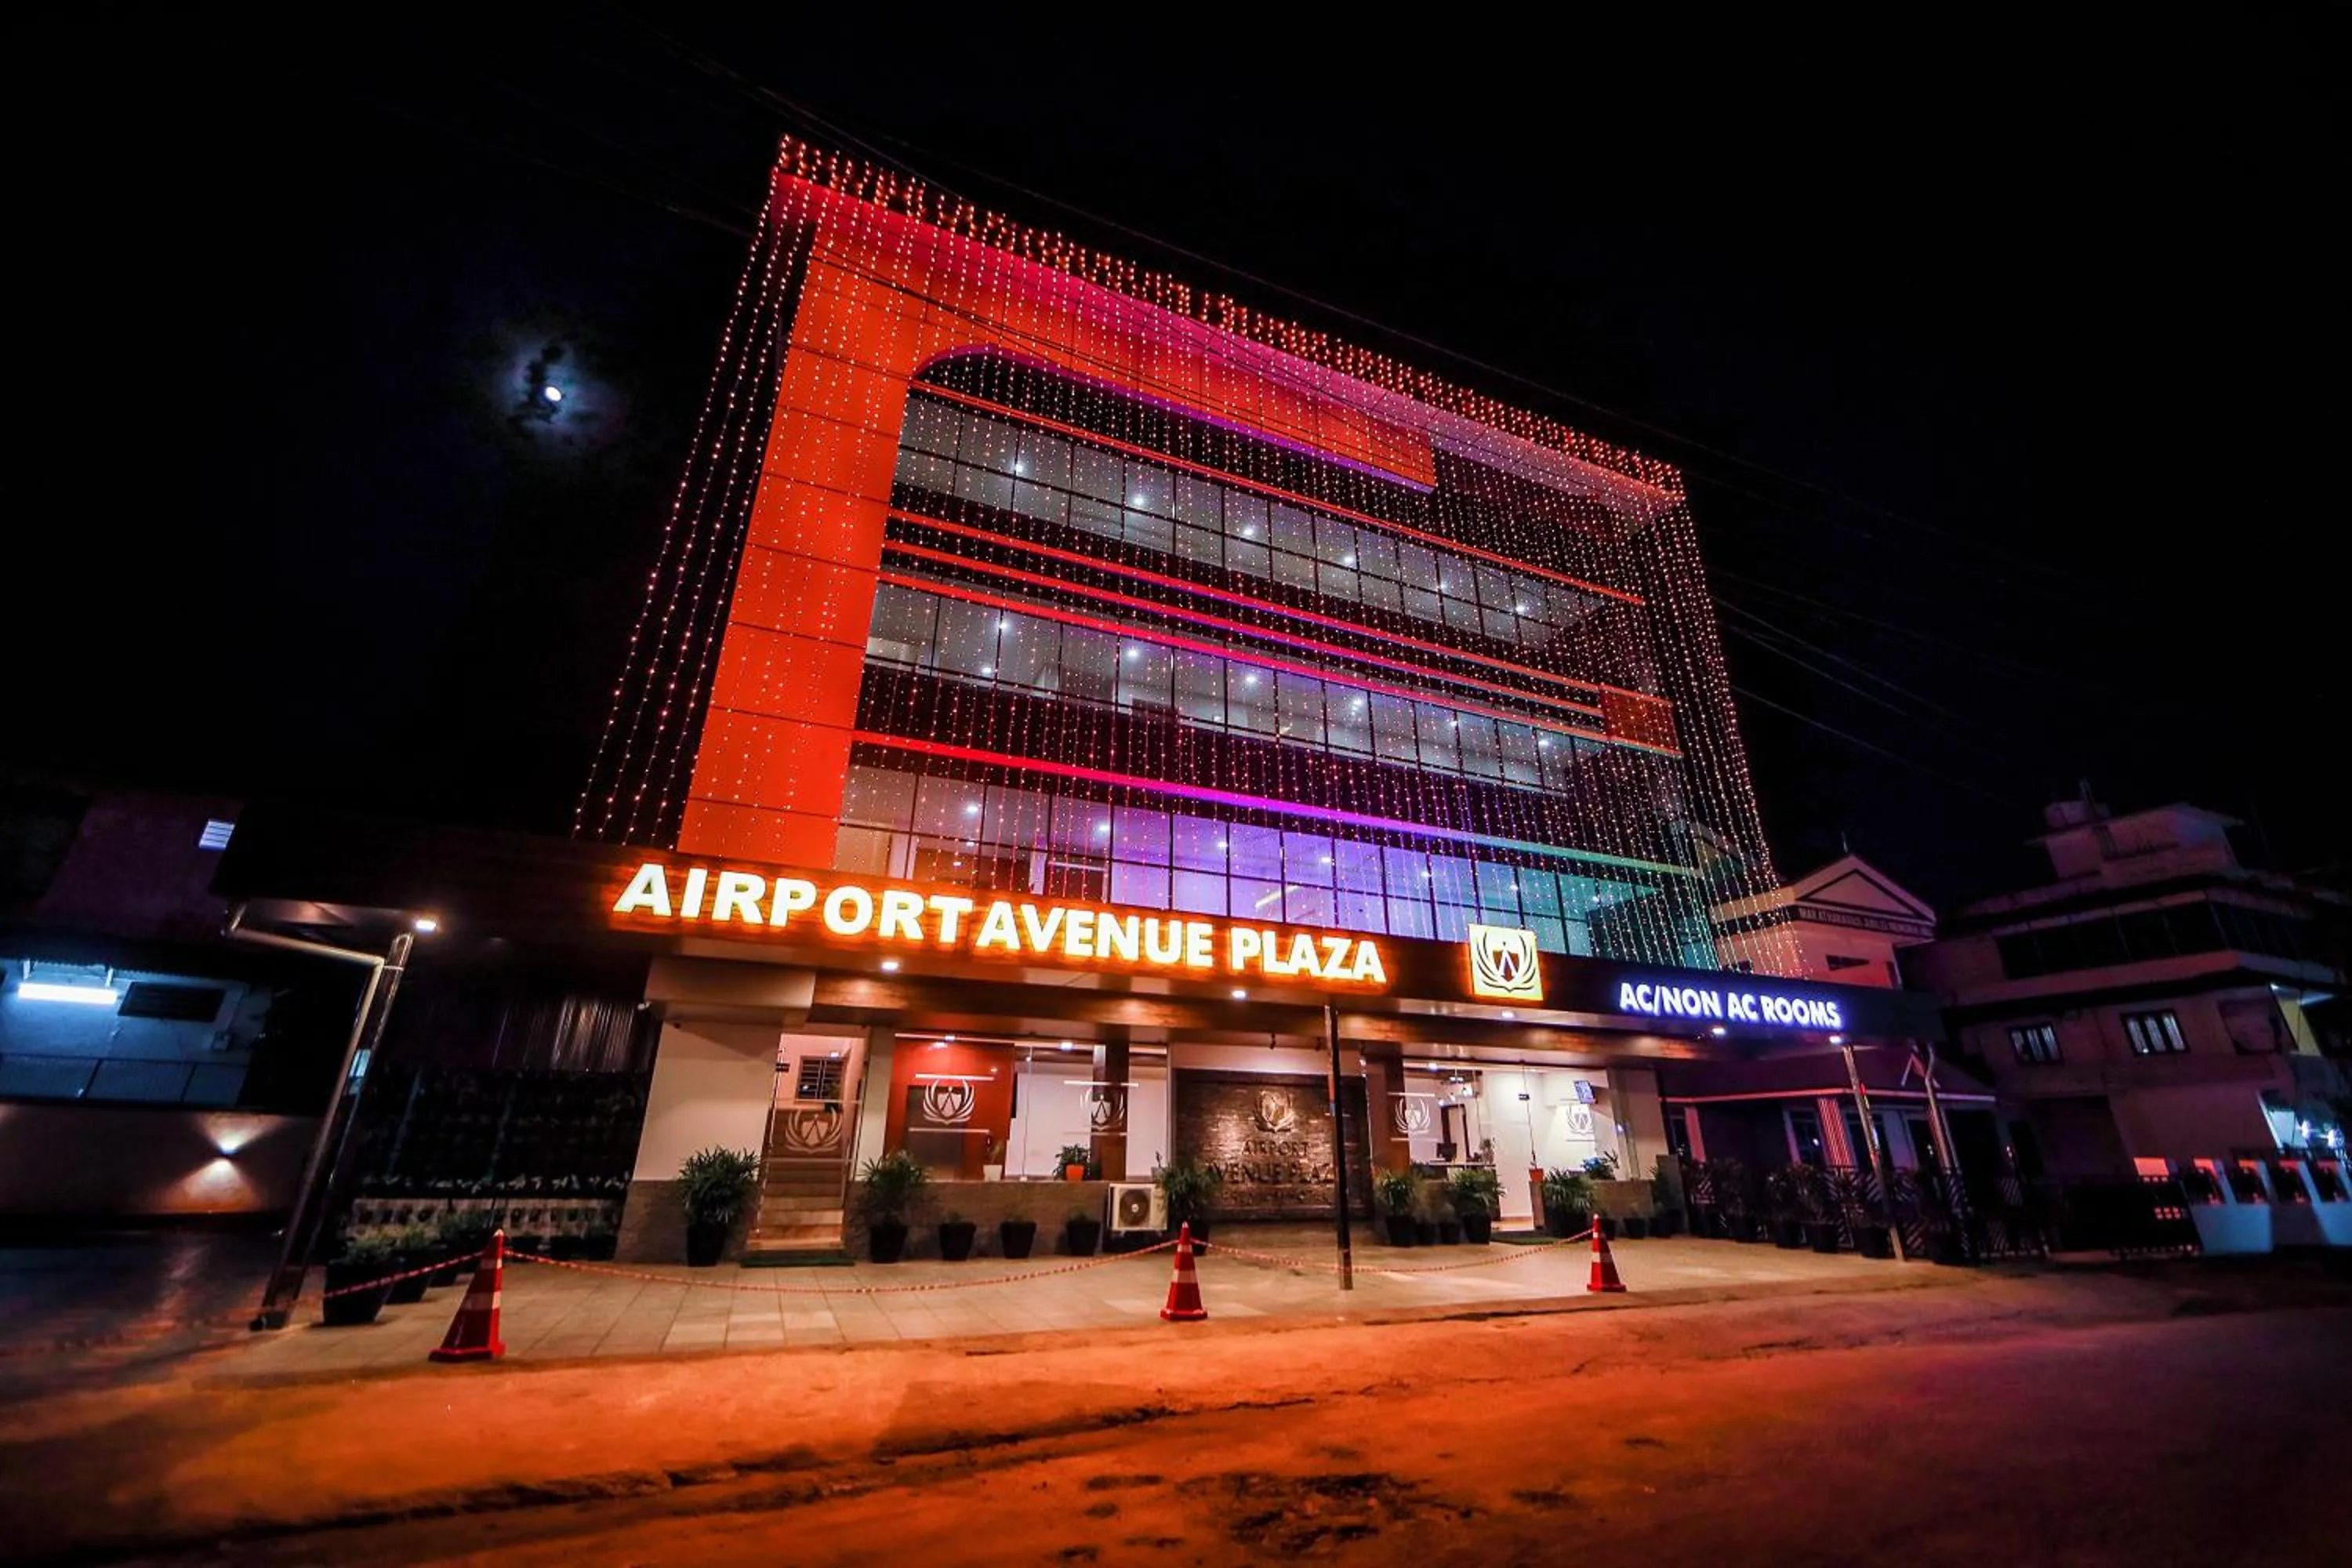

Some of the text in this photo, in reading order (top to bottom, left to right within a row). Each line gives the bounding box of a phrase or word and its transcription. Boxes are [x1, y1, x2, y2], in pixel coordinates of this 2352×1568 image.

[613, 863, 1387, 983] AIRPORT AVENUE PLAZA
[1620, 982, 1842, 1029] AC/NON AC ROOMS
[1241, 1139, 1308, 1156] AIRPORT
